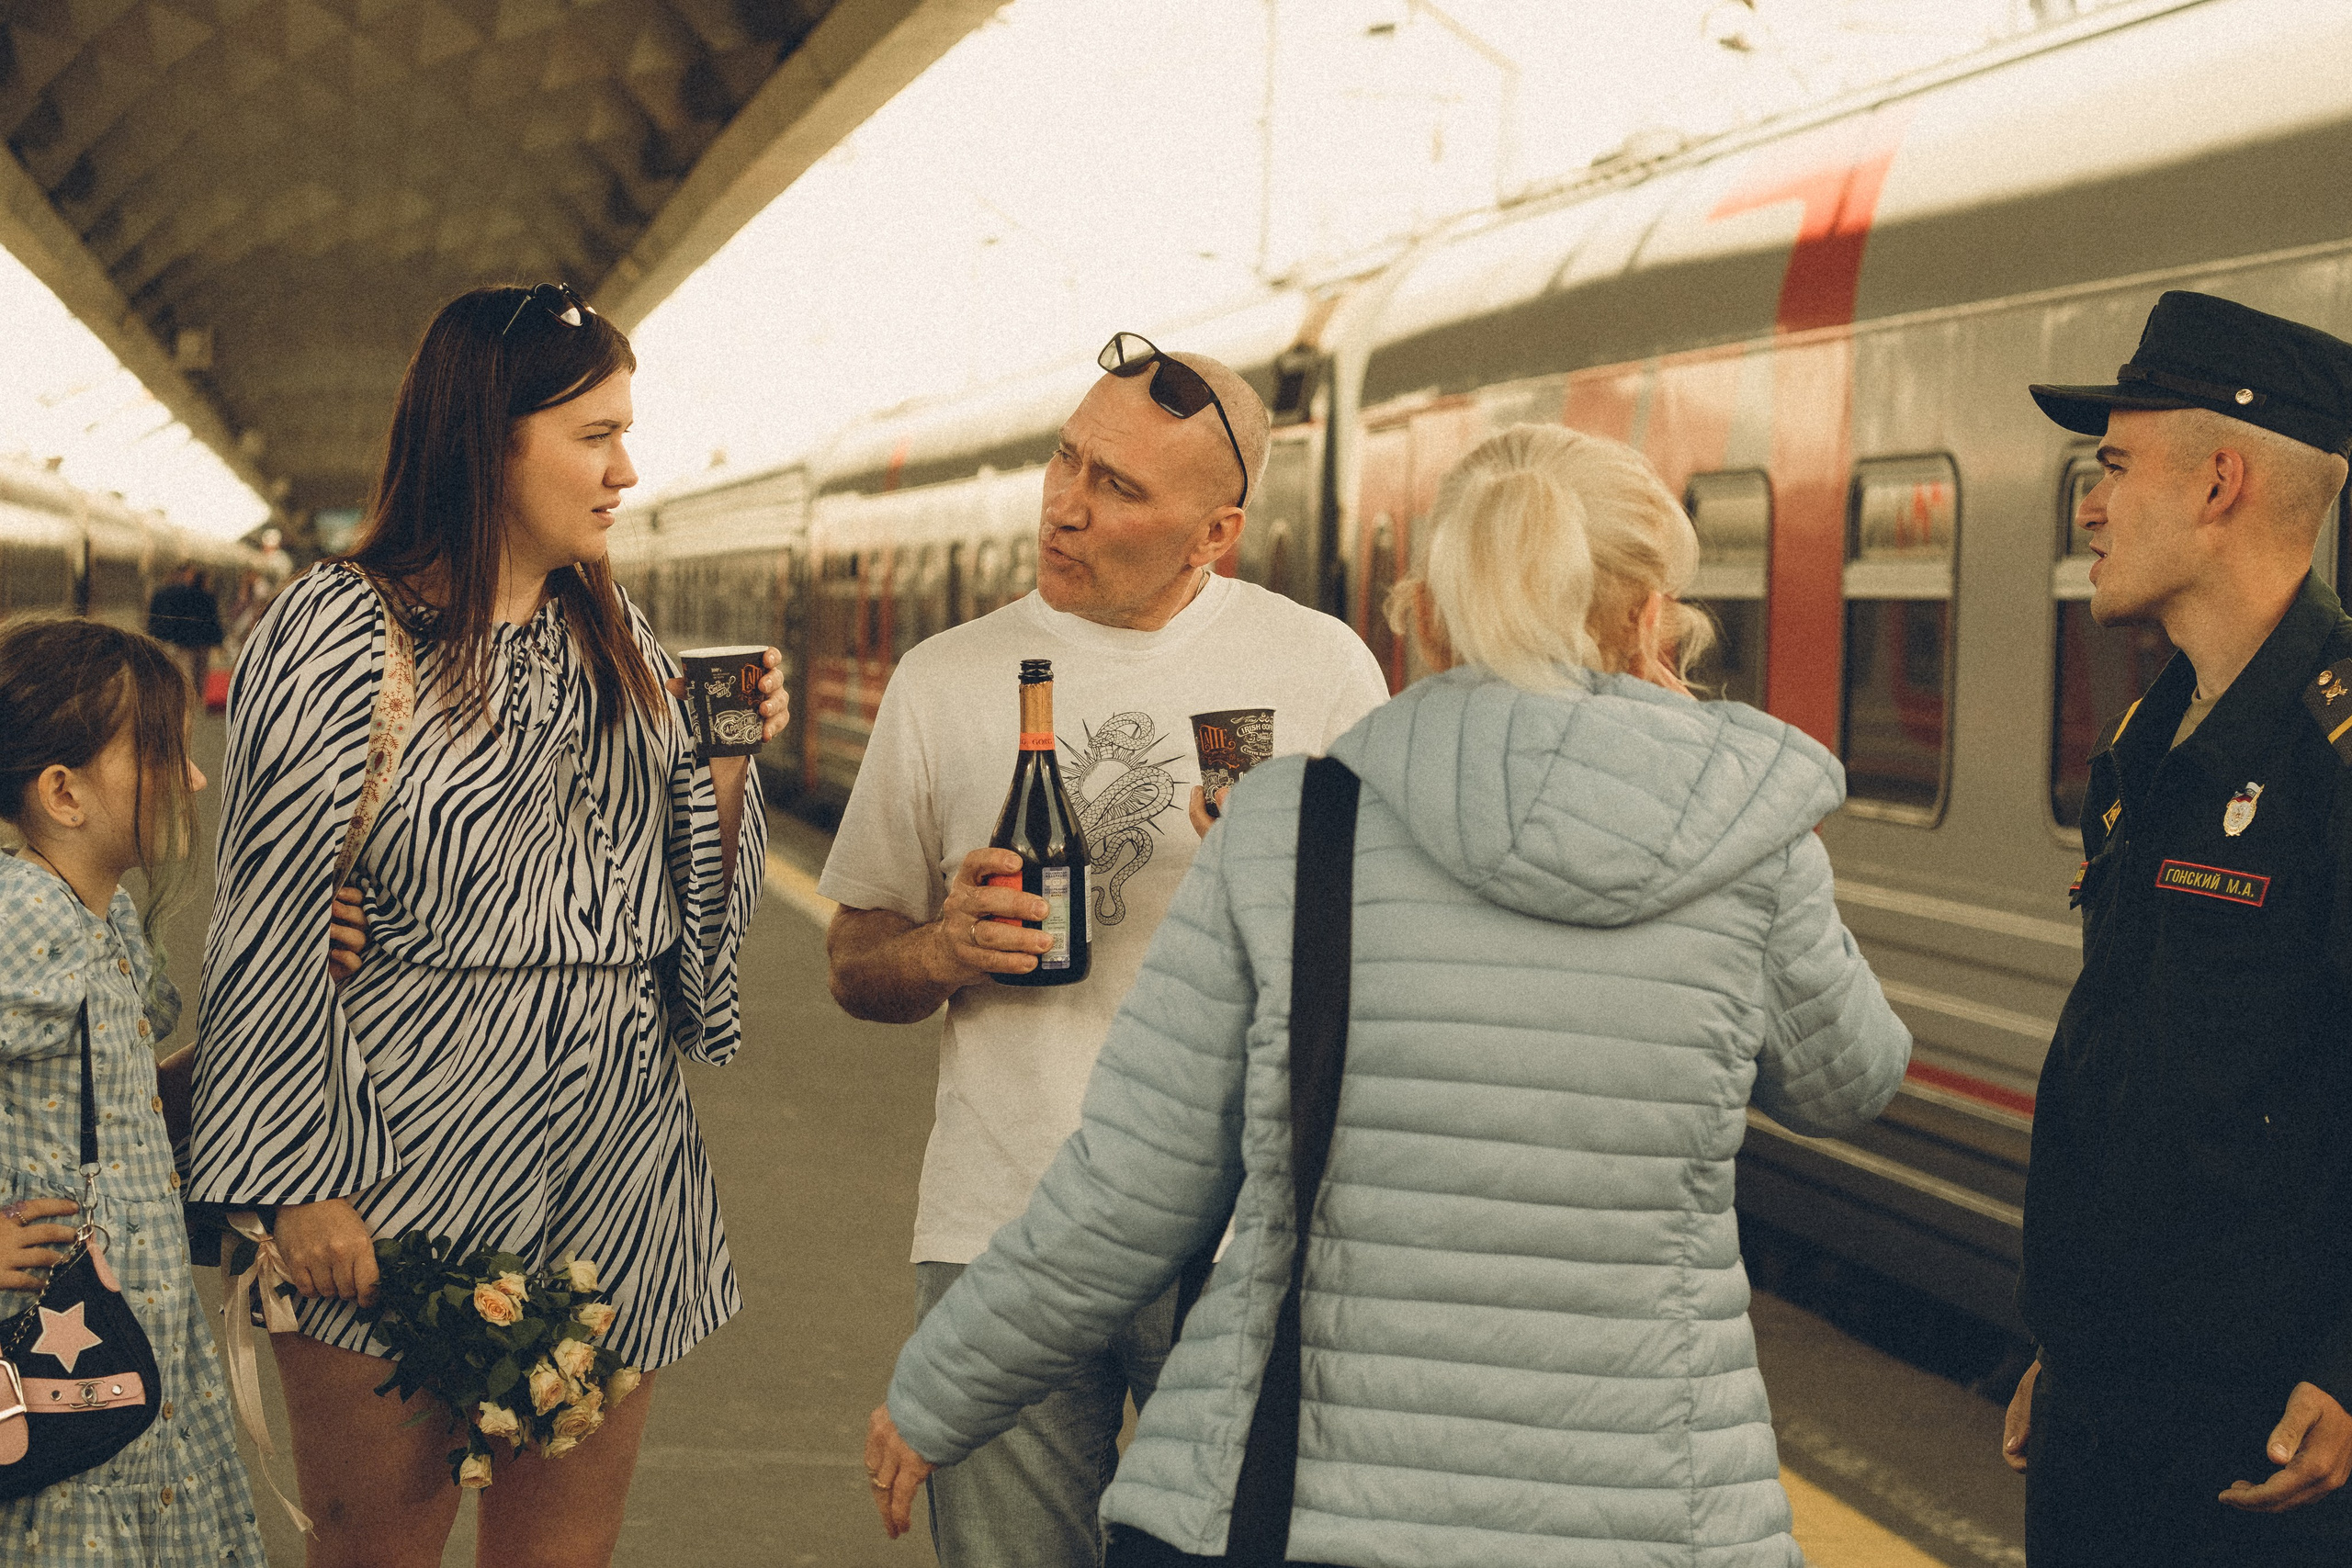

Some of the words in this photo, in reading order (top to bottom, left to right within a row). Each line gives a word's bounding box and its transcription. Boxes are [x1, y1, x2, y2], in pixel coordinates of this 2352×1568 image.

[1199, 724, 1237, 751] LATTE
[1241, 724, 1261, 734] IRISH
[2165, 868, 2222, 890] ГОНСКИЙ
[2225, 878, 2255, 897] М.А.
